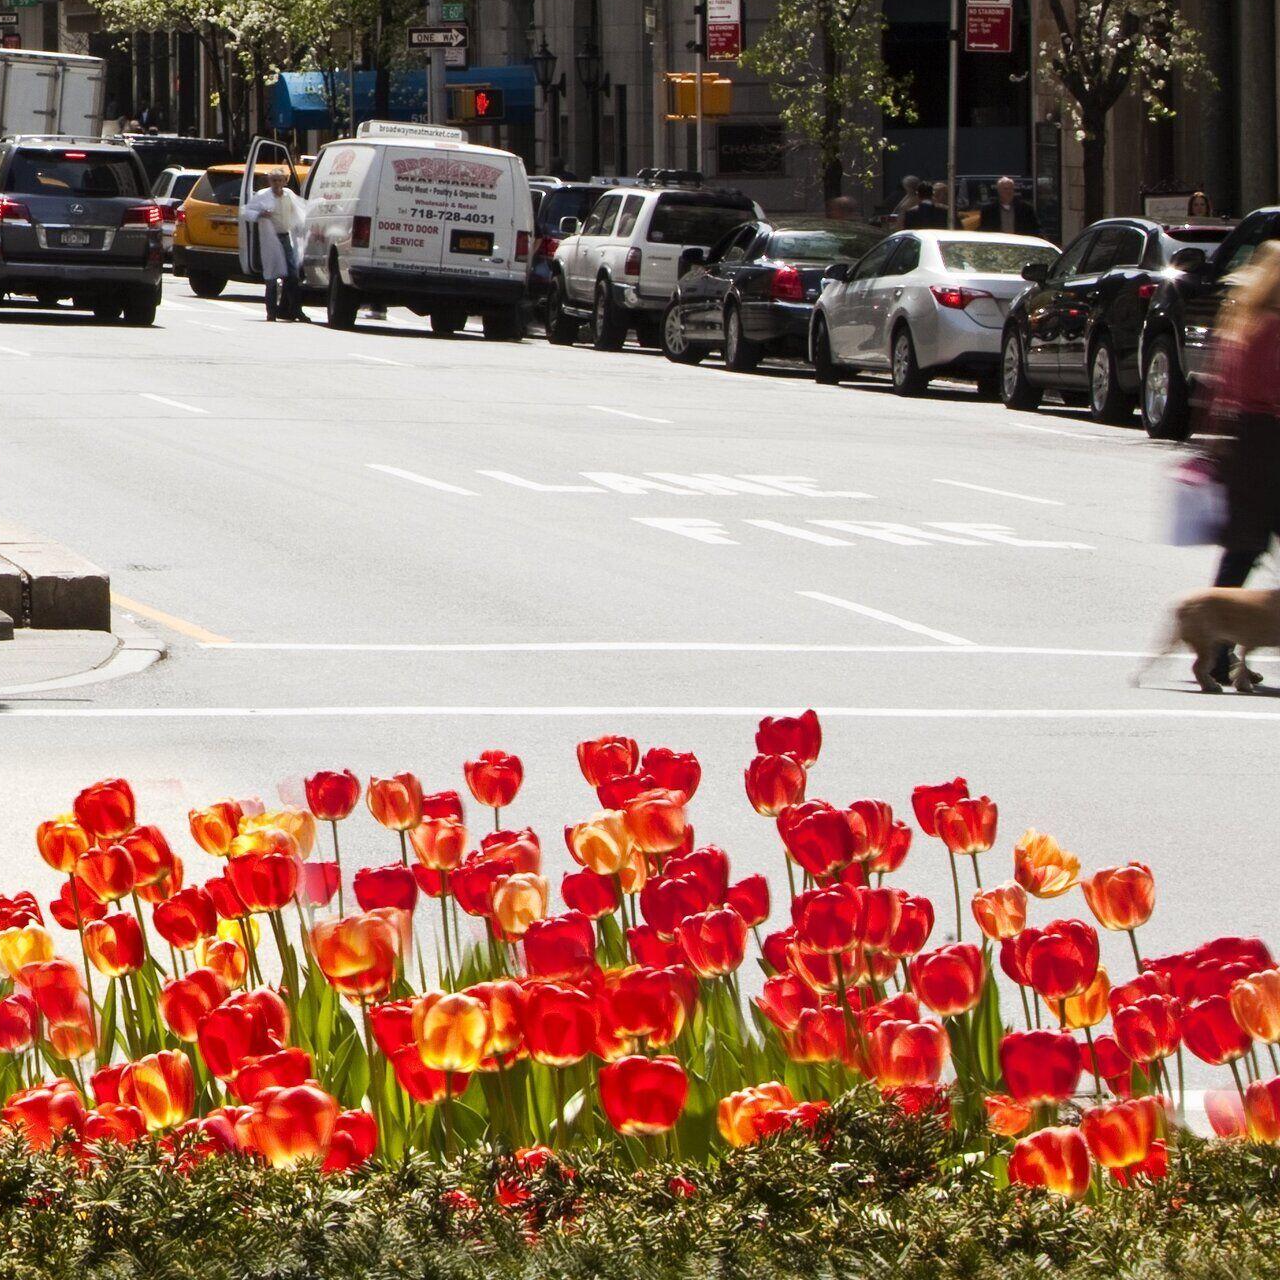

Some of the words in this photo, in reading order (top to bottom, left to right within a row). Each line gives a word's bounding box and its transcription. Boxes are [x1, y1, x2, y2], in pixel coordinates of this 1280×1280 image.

[416, 33, 435, 42] ONE
[443, 33, 460, 42] WAY
[379, 124, 460, 140] broadwaymeatmarket.com
[394, 183, 414, 194] Quality
[415, 185, 429, 194] Meat
[433, 187, 453, 198] Poultry
[459, 189, 480, 199] Organic
[414, 199, 448, 208] Wholesale
[410, 208, 495, 224] 718-728-4031
[378, 221, 401, 231] DOOR
[403, 223, 414, 232] TO
[416, 224, 439, 235] DOOR
[390, 236, 425, 248] SERVICE
[475, 469, 878, 500] LANE
[630, 516, 1098, 550] FIRE
